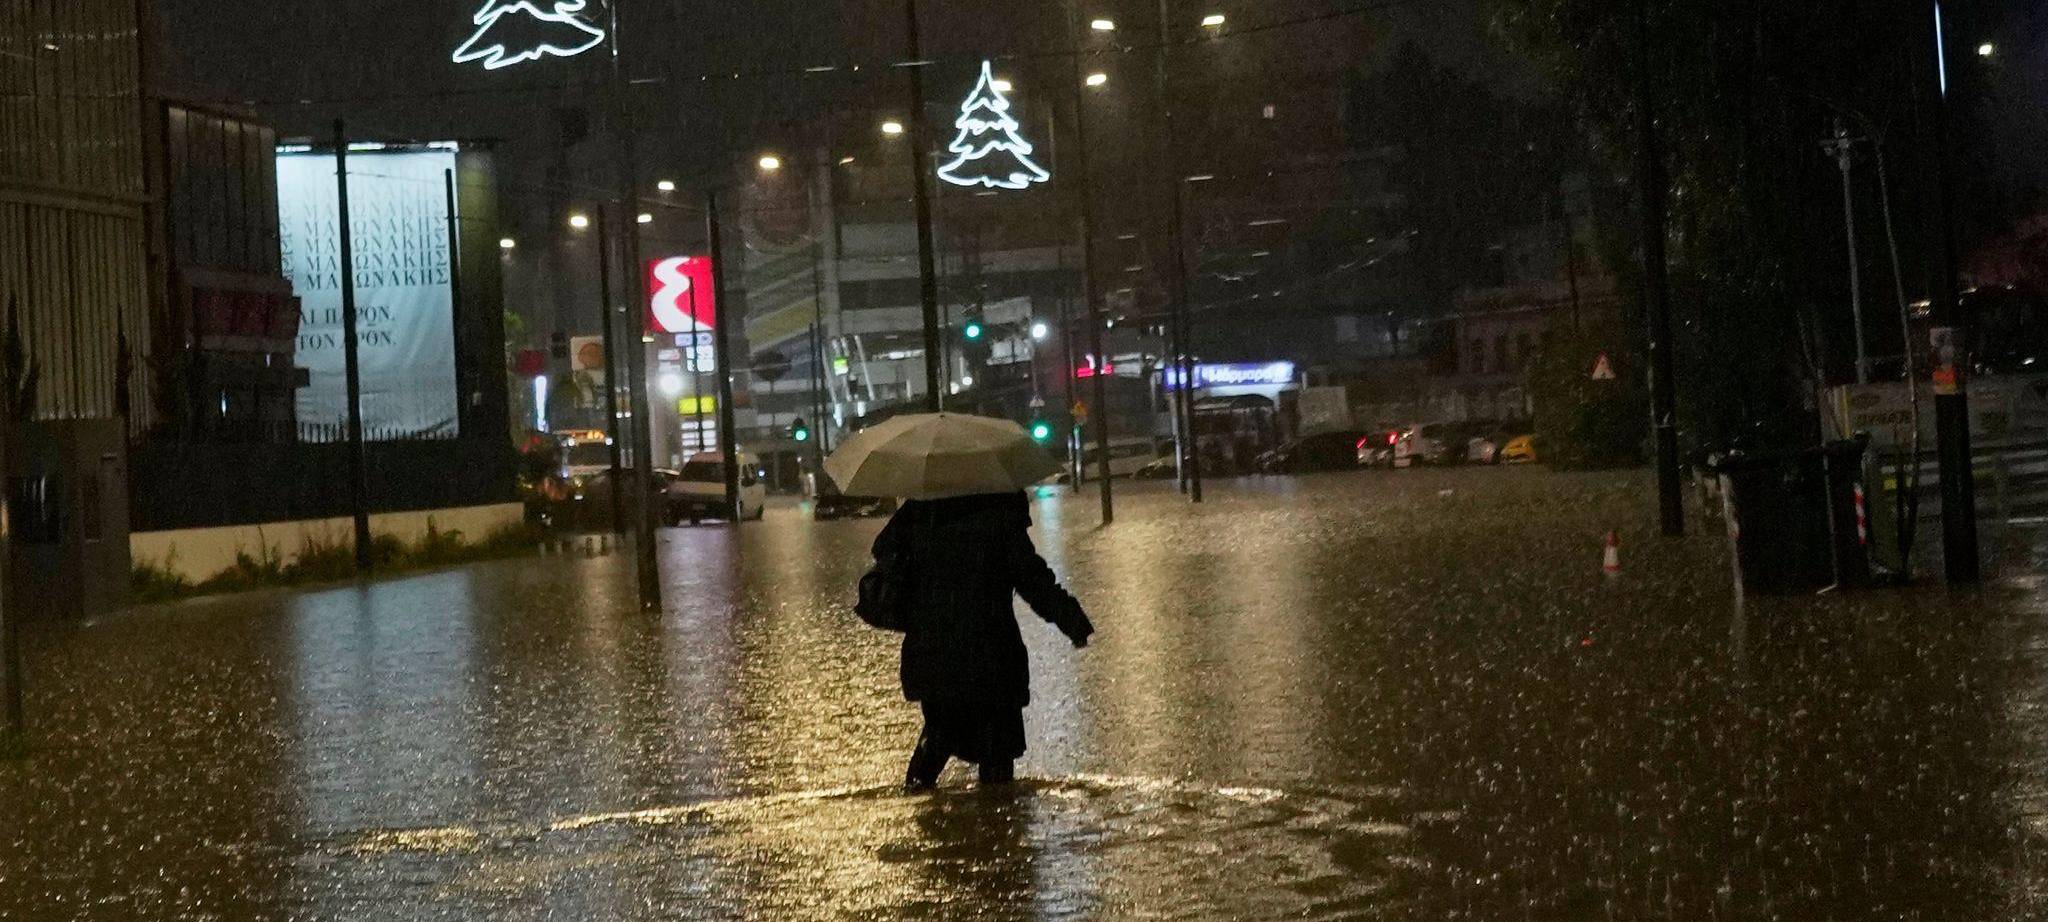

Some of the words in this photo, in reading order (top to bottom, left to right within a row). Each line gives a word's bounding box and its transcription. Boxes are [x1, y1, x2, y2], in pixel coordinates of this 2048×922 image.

[305, 215, 446, 237] ΜΑΩΝΑΚΗΣ
[305, 234, 448, 255] ΜΑΩΝΑΚΗΣ
[306, 251, 448, 272] ΜΑΩΝΑΚΗΣ
[306, 268, 449, 290] ΜΑΩΝΑΚΗΣ
